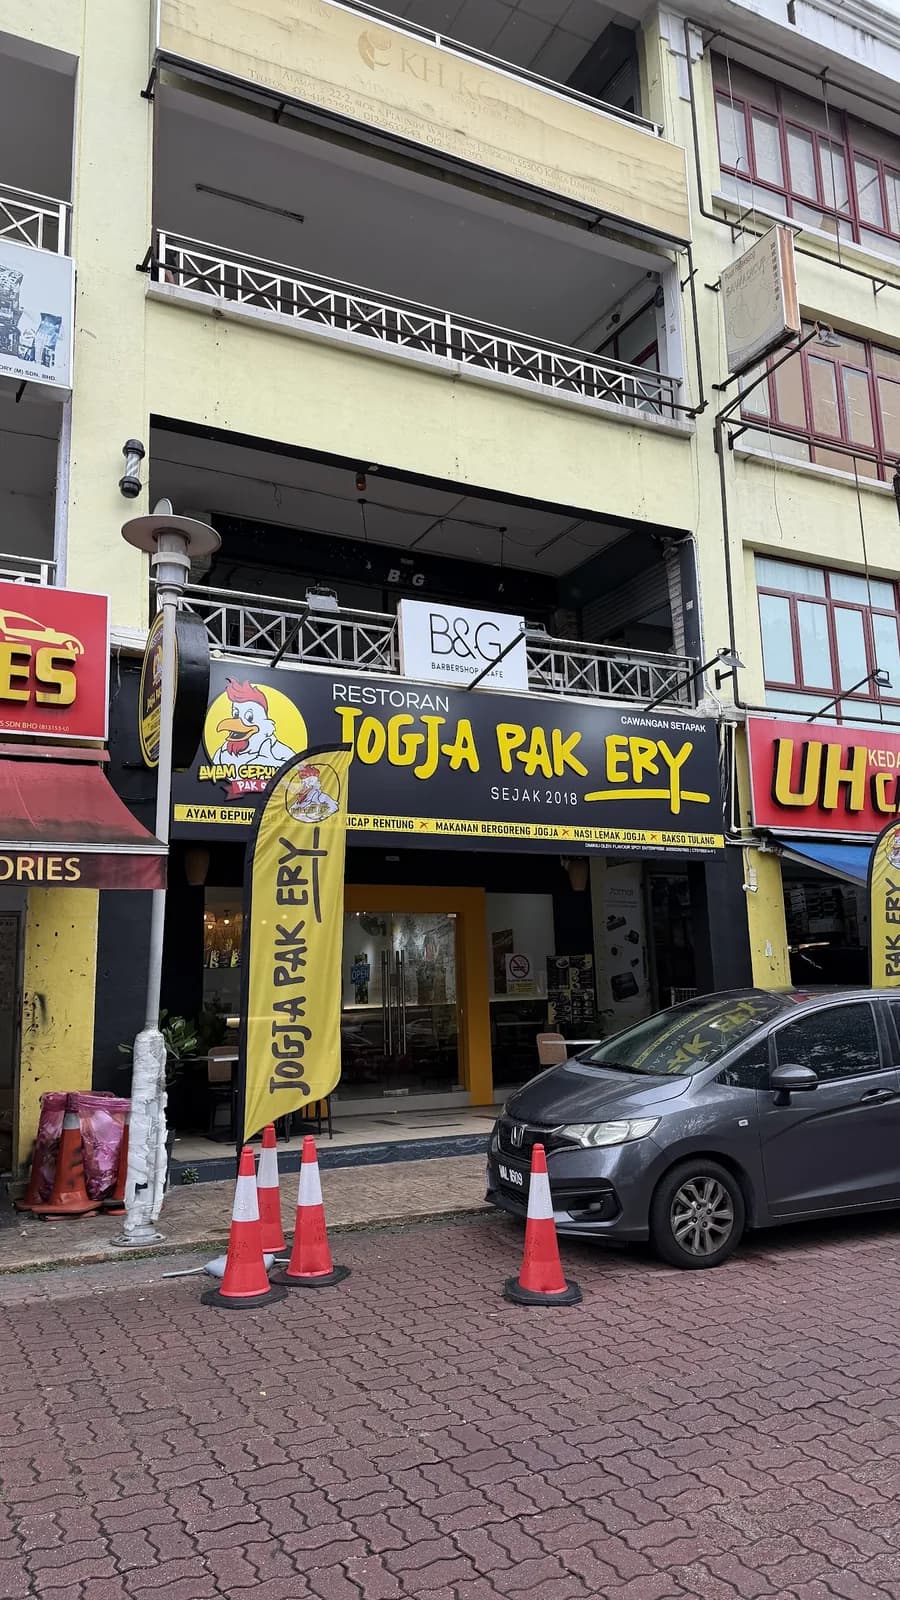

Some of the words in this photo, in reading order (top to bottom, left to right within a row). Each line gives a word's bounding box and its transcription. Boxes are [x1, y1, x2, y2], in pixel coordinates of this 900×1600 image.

[429, 613, 502, 663] B&G
[431, 661, 479, 675] BARBERSHOP
[332, 683, 449, 713] RESTORAN
[5, 720, 21, 728] SDN
[620, 715, 670, 730] CAWANGAN
[670, 721, 706, 732] SETAPAK
[199, 764, 236, 783] AYAM
[334, 706, 480, 780] JOGJA
[496, 723, 589, 779] PAK
[605, 734, 693, 815] ERY
[774, 737, 868, 811] UH
[490, 786, 541, 803] SEJAK
[546, 790, 577, 805] 2018
[186, 809, 217, 821] AYAM
[346, 816, 370, 827] ICAP
[373, 818, 414, 829] RENTUNG
[435, 821, 479, 833] MAKANAN
[481, 823, 531, 836] BERGORENG
[533, 826, 559, 837] JOGJA
[574, 828, 593, 840] NASI
[594, 830, 620, 841] LEMAK
[623, 831, 646, 842] JOGJA
[661, 833, 686, 844] BAKSO
[688, 834, 715, 845] TULANG
[275, 837, 328, 906] ERY
[272, 920, 306, 988] PAK
[269, 995, 313, 1097] JOGJA
[509, 1168, 523, 1187] 1609
